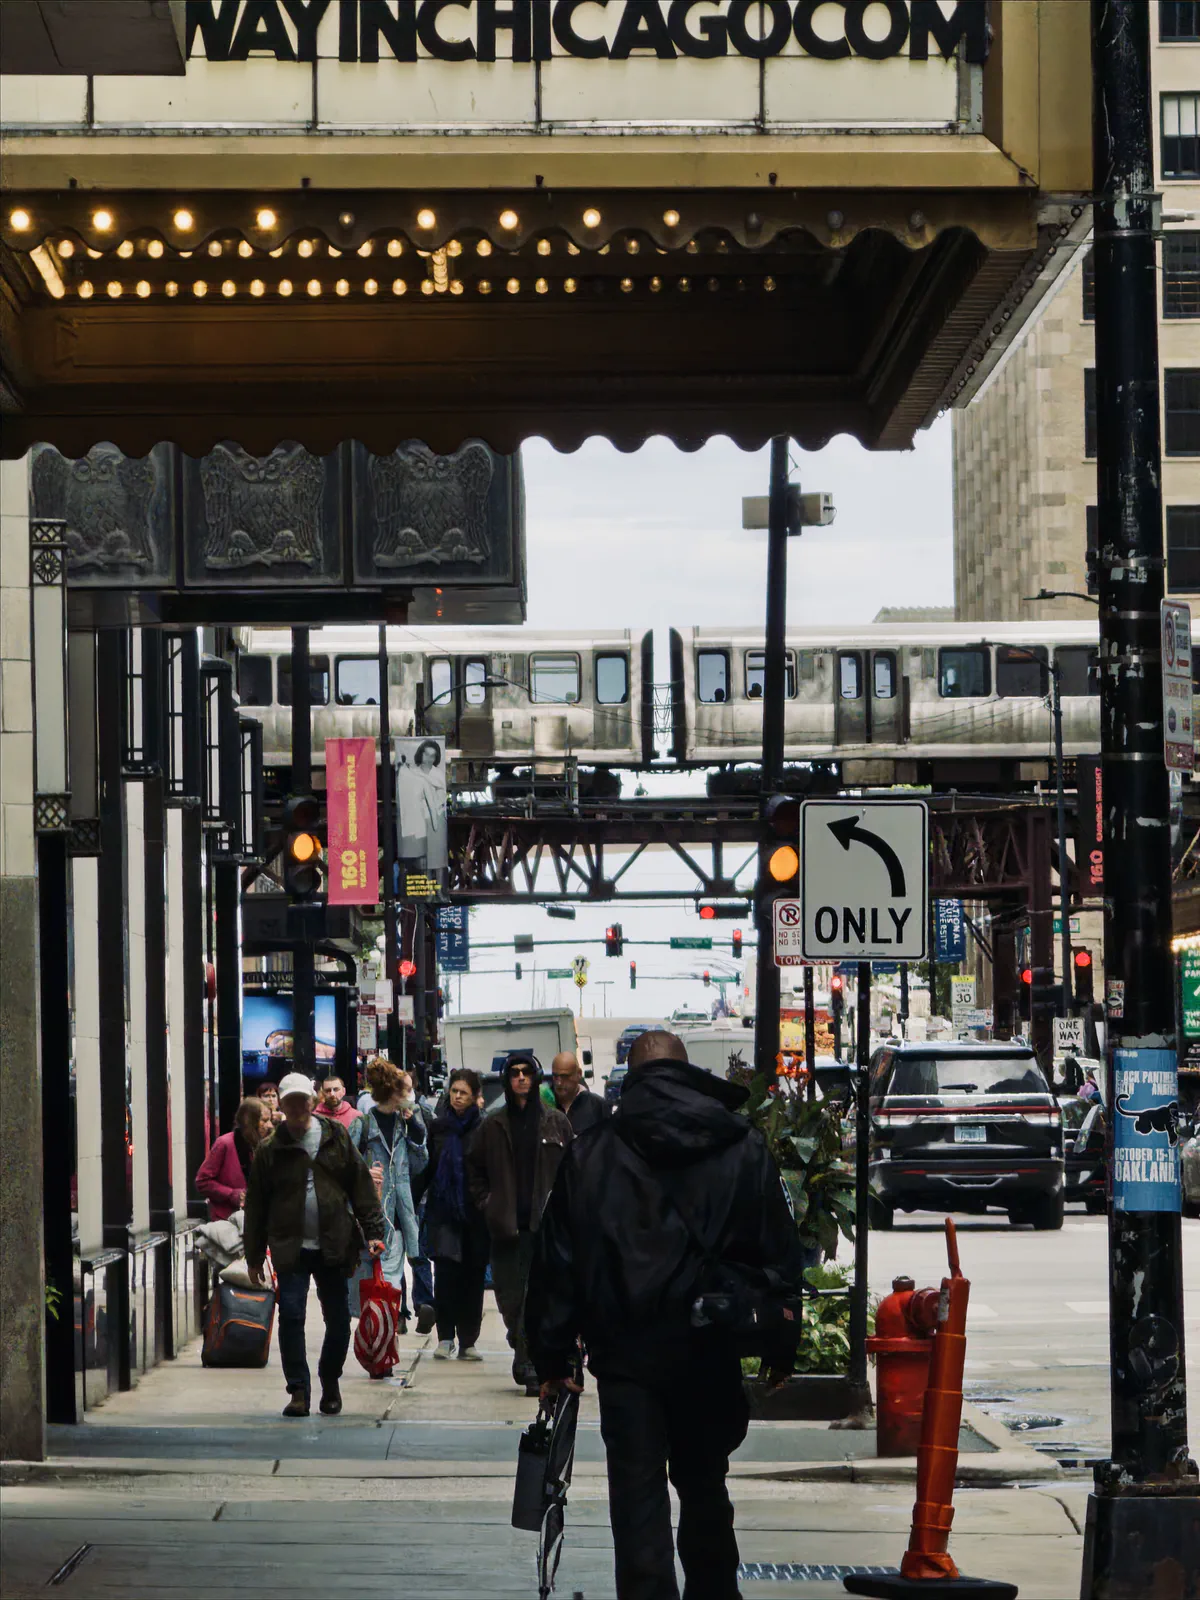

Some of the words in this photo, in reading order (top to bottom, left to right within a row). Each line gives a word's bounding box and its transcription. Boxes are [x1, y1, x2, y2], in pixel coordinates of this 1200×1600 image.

[346, 754, 357, 790] STYLE
[340, 850, 358, 889] 160
[1089, 849, 1104, 885] 160
[814, 906, 912, 944] ONLY
[778, 938, 789, 946] NO
[779, 956, 801, 965] TOW
[955, 993, 972, 1004] 30
[1058, 1021, 1079, 1030] ONE
[1059, 1030, 1081, 1041] WAY
[1114, 1147, 1153, 1161] OCTOBER
[1114, 1160, 1178, 1186] OAKLAND,
